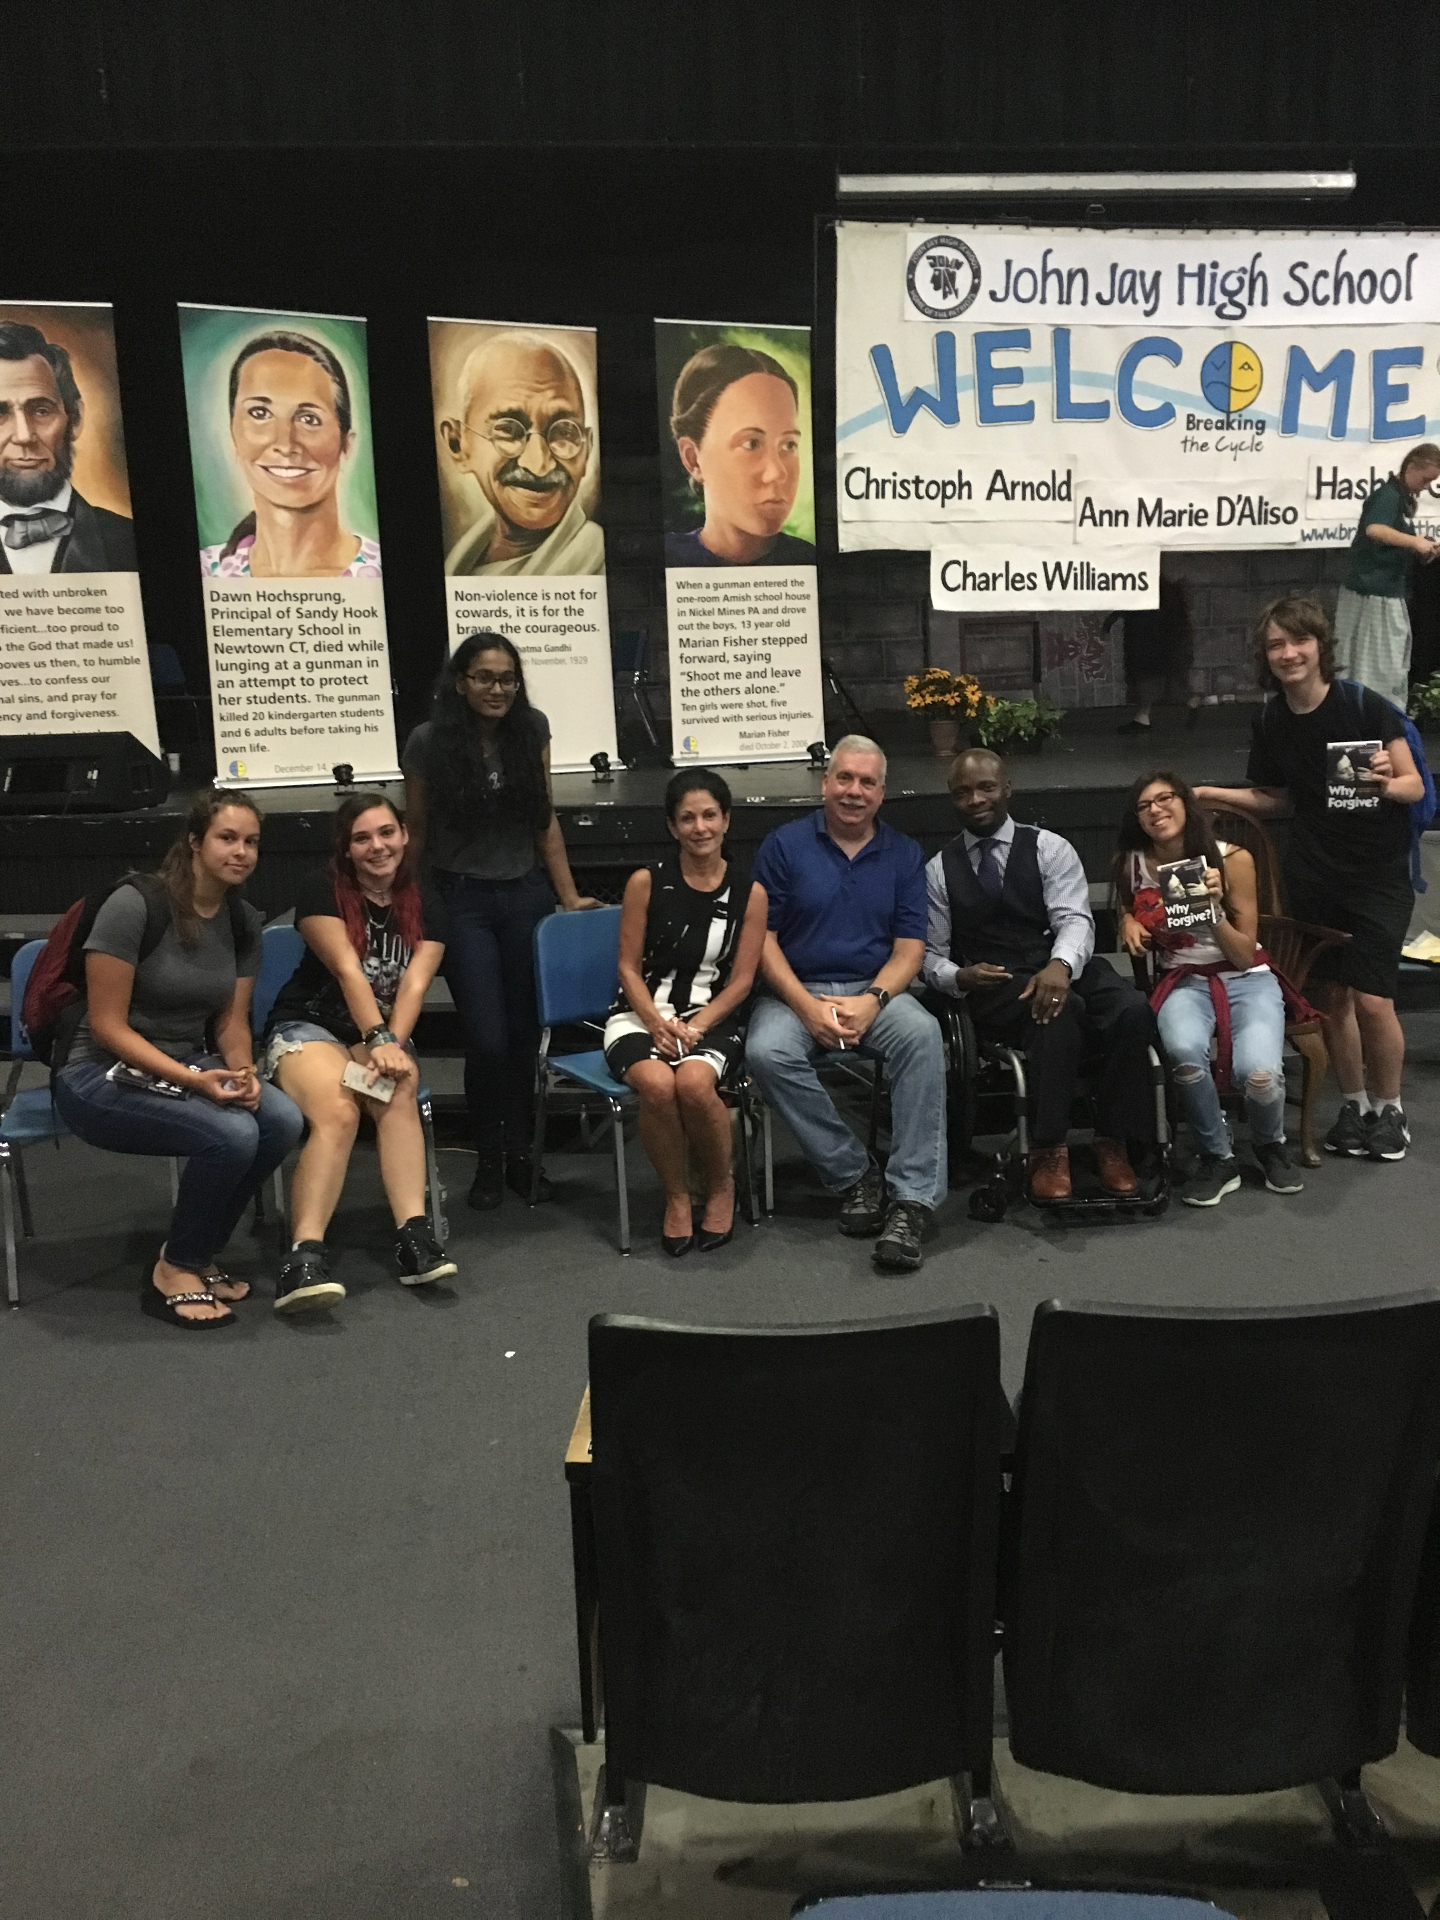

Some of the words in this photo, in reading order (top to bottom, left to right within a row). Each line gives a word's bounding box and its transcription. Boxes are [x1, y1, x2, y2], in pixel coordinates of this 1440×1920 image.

[989, 248, 1089, 306] John
[1095, 262, 1162, 317] Jay
[1177, 252, 1268, 320] High
[1283, 248, 1418, 307] School
[1186, 413, 1266, 435] Breaking
[1180, 435, 1210, 453] the
[1215, 434, 1264, 461] Cycle
[844, 467, 972, 508] Christoph
[985, 469, 1072, 501] Arnold
[1079, 496, 1129, 527] Ann
[1137, 497, 1208, 527] Marie
[1216, 494, 1299, 526] D'Aliso
[940, 559, 1037, 592] Charles
[1042, 561, 1149, 592] Williams
[676, 581, 703, 590] When
[713, 581, 751, 591] gunman
[753, 579, 788, 588] entered
[790, 578, 805, 587] the
[22, 588, 49, 598] with
[53, 587, 107, 597] unbroken
[210, 590, 252, 602] Dawn
[256, 590, 346, 604] Hochsprung,
[454, 590, 538, 601] Non-violence
[542, 589, 551, 600] is
[554, 590, 576, 600] not
[579, 589, 598, 600] for
[676, 595, 720, 604] one-room
[722, 593, 752, 602] Amish
[754, 592, 783, 601] school
[785, 591, 811, 600] house
[4, 608, 23, 616] we
[26, 606, 54, 616] have
[57, 605, 101, 615] become
[105, 605, 125, 614] too
[211, 607, 271, 622] Principal
[276, 607, 291, 619] of
[296, 607, 339, 621] Sandy
[343, 606, 378, 618] Hook
[456, 606, 512, 619] cowards,
[516, 606, 525, 617] it
[529, 606, 539, 617] is
[542, 605, 560, 617] for
[564, 605, 585, 616] the
[677, 608, 686, 617] in
[689, 607, 715, 616] Nickel
[717, 607, 745, 616] Mines
[748, 606, 760, 615] PA
[762, 605, 779, 614] and
[781, 605, 807, 614] drove
[70, 622, 104, 634] proud
[107, 623, 119, 631] to
[212, 624, 293, 639] Elementary
[298, 623, 344, 636] School
[349, 624, 361, 635] in
[500, 623, 522, 634] the
[525, 624, 600, 635] courageous.
[677, 622, 694, 631] out
[697, 621, 710, 630] the
[713, 621, 737, 631] boys,
[741, 620, 751, 629] 13
[754, 620, 773, 630] year
[776, 619, 791, 628] old
[5, 642, 24, 651] the
[28, 641, 52, 651] God
[55, 640, 79, 650] that
[83, 639, 113, 649] made
[117, 639, 134, 648] us!
[214, 642, 284, 654] Newtown
[289, 641, 309, 654] CT,
[313, 640, 343, 652] died
[348, 640, 384, 651] while
[679, 637, 720, 648] Marian
[723, 635, 758, 647] Fisher
[761, 633, 808, 648] stepped
[544, 643, 572, 652] Gandhi
[34, 660, 47, 668] us
[50, 658, 80, 668] then,
[84, 658, 95, 667] to
[98, 656, 141, 666] humble
[569, 656, 588, 665] 1929
[679, 652, 730, 664] forward,
[733, 651, 772, 664] saying
[215, 659, 270, 674] lunging
[274, 660, 289, 670] at
[293, 661, 301, 670] a
[306, 659, 363, 672] gunman
[367, 657, 379, 668] in
[45, 675, 88, 685] confess
[91, 675, 110, 684] our
[724, 671, 742, 680] me
[745, 668, 768, 679] and
[771, 667, 801, 678] leave
[217, 679, 234, 689] an
[239, 677, 296, 690] attempt
[300, 676, 315, 687] to
[319, 675, 369, 689] protect
[18, 693, 43, 704] sins,
[47, 692, 68, 702] and
[72, 692, 97, 703] pray
[101, 691, 117, 701] for
[681, 686, 700, 698] the
[703, 685, 741, 696] others
[218, 694, 242, 706] her
[246, 693, 311, 705] students.
[315, 694, 334, 703] The
[337, 693, 380, 704] gunman
[681, 703, 697, 712] Ten
[700, 702, 718, 713] girls
[721, 702, 744, 710] were
[746, 700, 768, 709] shot,
[770, 699, 787, 708] five
[26, 710, 47, 720] and
[51, 709, 120, 721] forgiveness.
[219, 711, 249, 722] killed
[252, 711, 265, 721] 20
[268, 709, 337, 721] kindergarten
[340, 708, 384, 718] students
[681, 715, 720, 725] survived
[722, 713, 743, 723] with
[746, 712, 777, 721] serious
[779, 710, 814, 721] injuries.
[220, 728, 241, 738] and
[244, 728, 251, 737] 6
[254, 727, 287, 737] adults
[290, 725, 325, 735] before
[328, 725, 361, 736] taking
[364, 723, 379, 732] his
[739, 731, 766, 739] Marian
[768, 729, 790, 738] Fisher
[222, 745, 246, 753] own
[249, 743, 270, 753] life.
[739, 742, 754, 751] died
[755, 741, 781, 750] October
[274, 763, 314, 774] December
[317, 763, 329, 773] 14,
[1327, 785, 1356, 798] Why
[1327, 796, 1380, 810] Forgive?
[1165, 904, 1190, 915] Why
[1166, 909, 1211, 928] Forgive?
